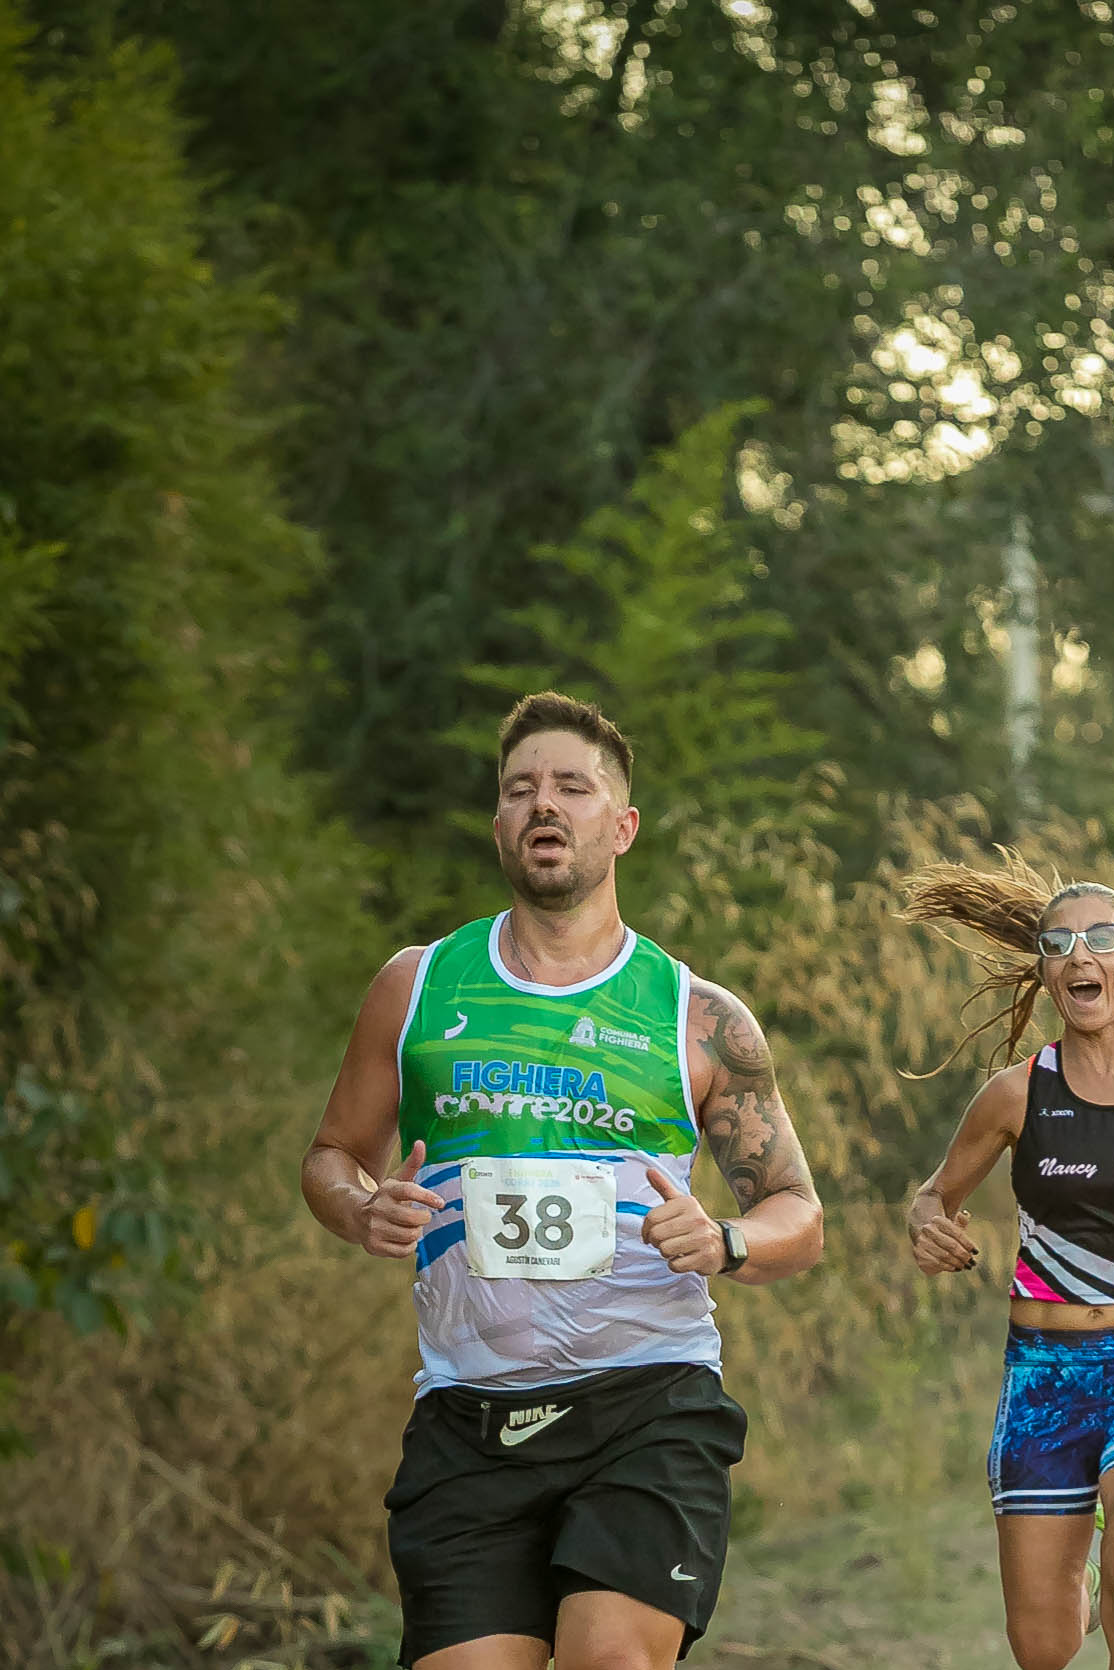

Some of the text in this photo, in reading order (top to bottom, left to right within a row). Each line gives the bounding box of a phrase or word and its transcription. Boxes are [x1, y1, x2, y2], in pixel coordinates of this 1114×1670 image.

[599, 1033, 649, 1052] FIGHIERA
[600, 1026, 651, 1044] COMUNA DE
[453, 1060, 608, 1104] FIGHIERA
[1038, 1158, 1098, 1179] Nancy
[492, 1193, 574, 1251] 38
[509, 1404, 557, 1427] NIKE
